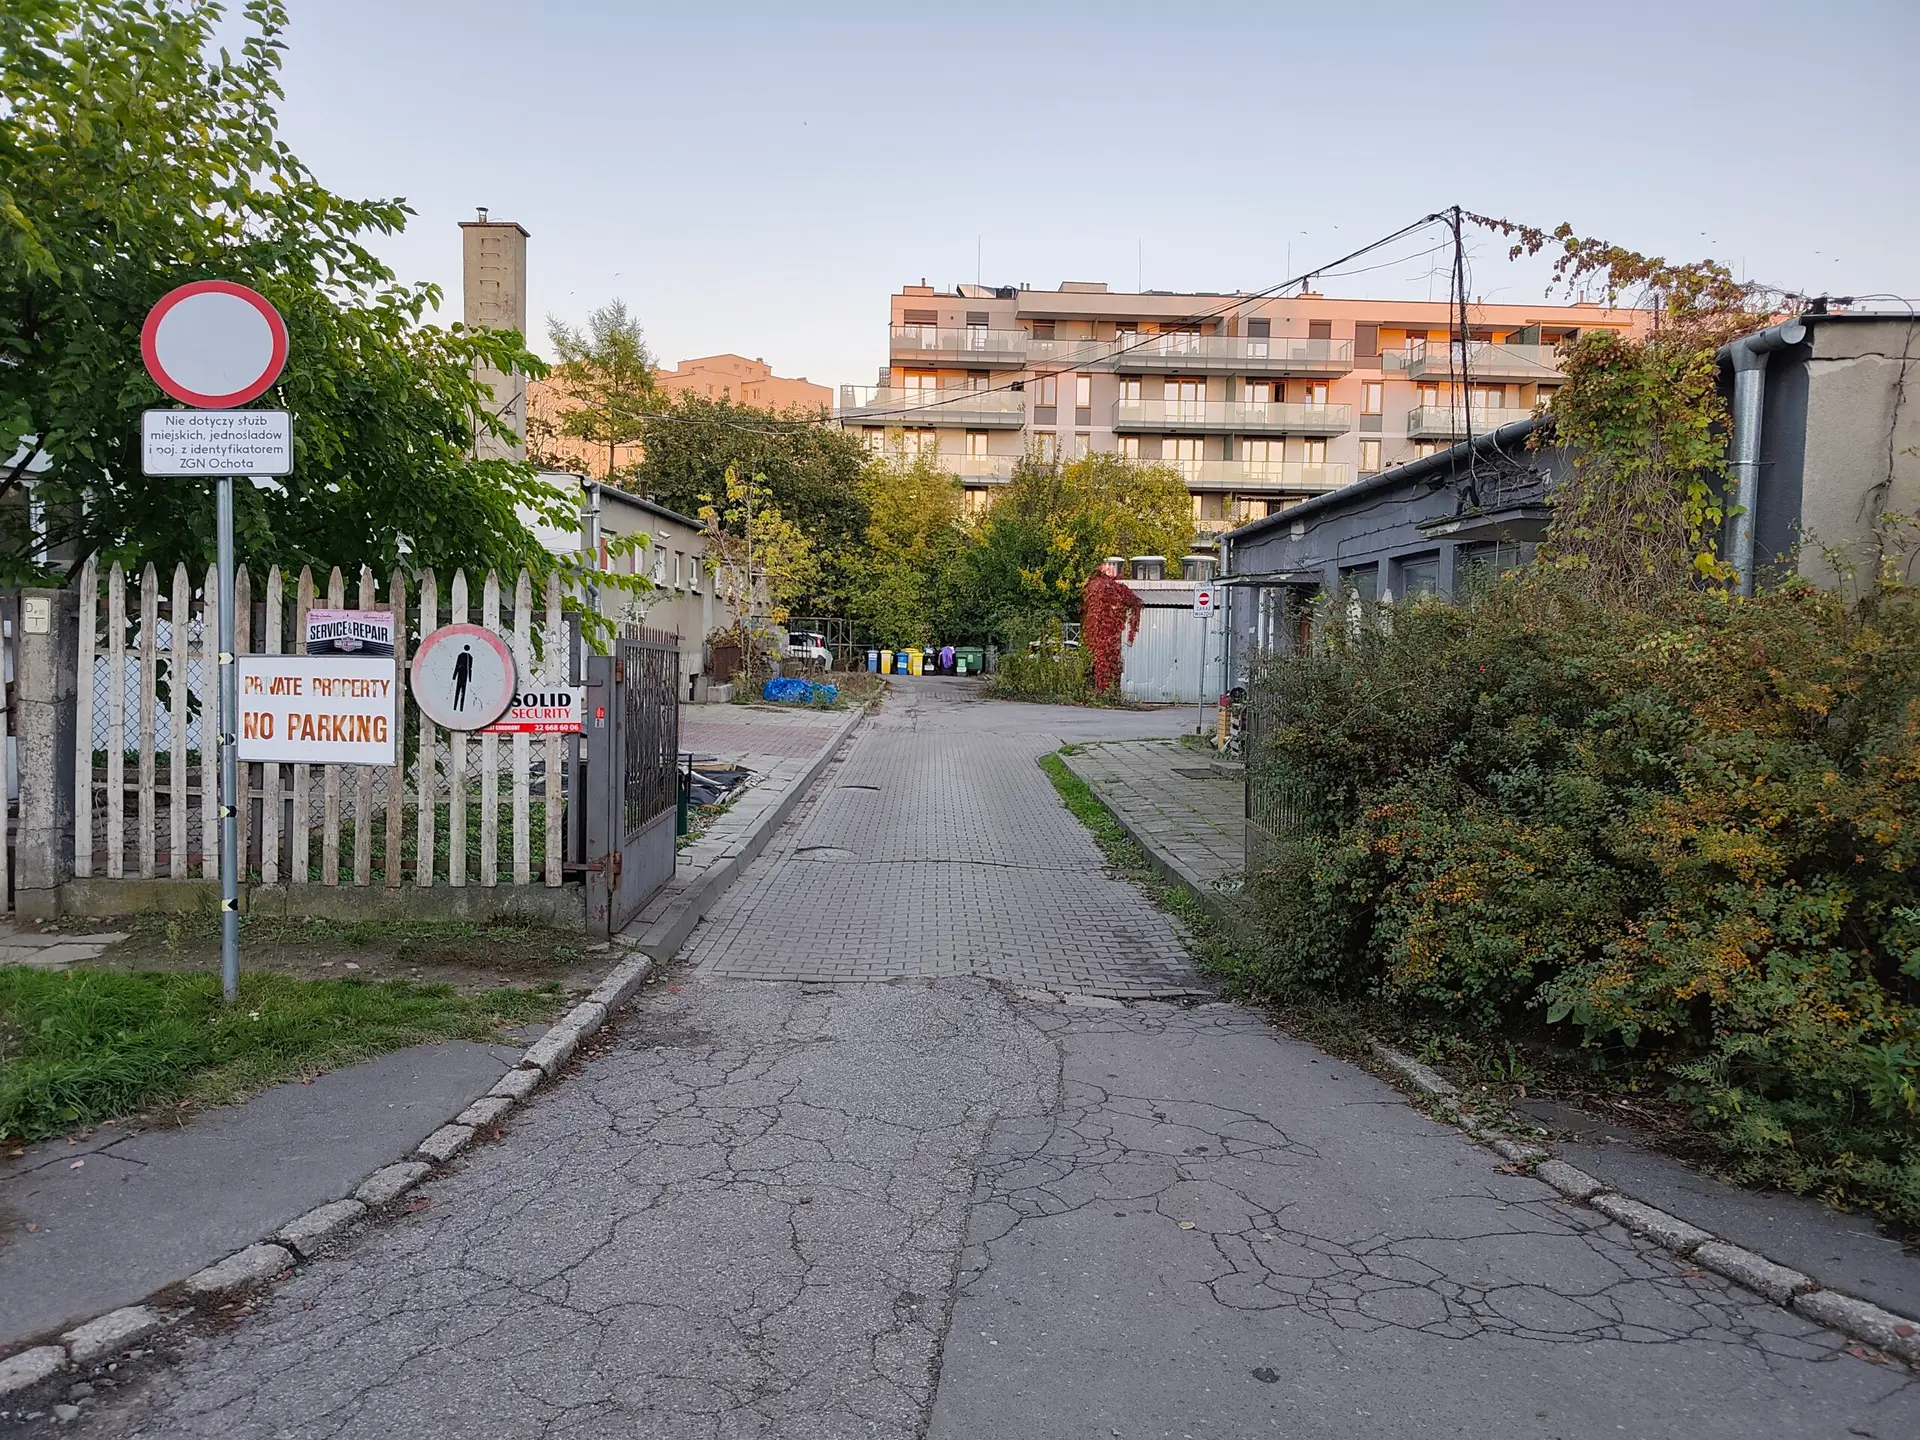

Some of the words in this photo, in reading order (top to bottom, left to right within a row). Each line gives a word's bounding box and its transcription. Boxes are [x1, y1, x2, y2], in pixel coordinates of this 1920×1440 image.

[166, 416, 185, 426] Nie
[189, 416, 234, 428] dotyczy
[238, 416, 268, 426] służb
[151, 430, 206, 442] miejskich,
[209, 430, 282, 442] jednośladów
[149, 444, 152, 454] i
[190, 444, 284, 457] identyfikatorem
[180, 458, 205, 469] ZGN
[209, 458, 254, 469] Ochota
[310, 621, 348, 640] SERVICE
[353, 622, 388, 642] REPAIR
[244, 676, 302, 696] PRIVATE
[312, 677, 391, 698] PROPERTY
[511, 693, 571, 707] SOLID
[511, 708, 571, 719] SECURITY
[244, 712, 274, 740] NO
[287, 713, 388, 743] PARKING
